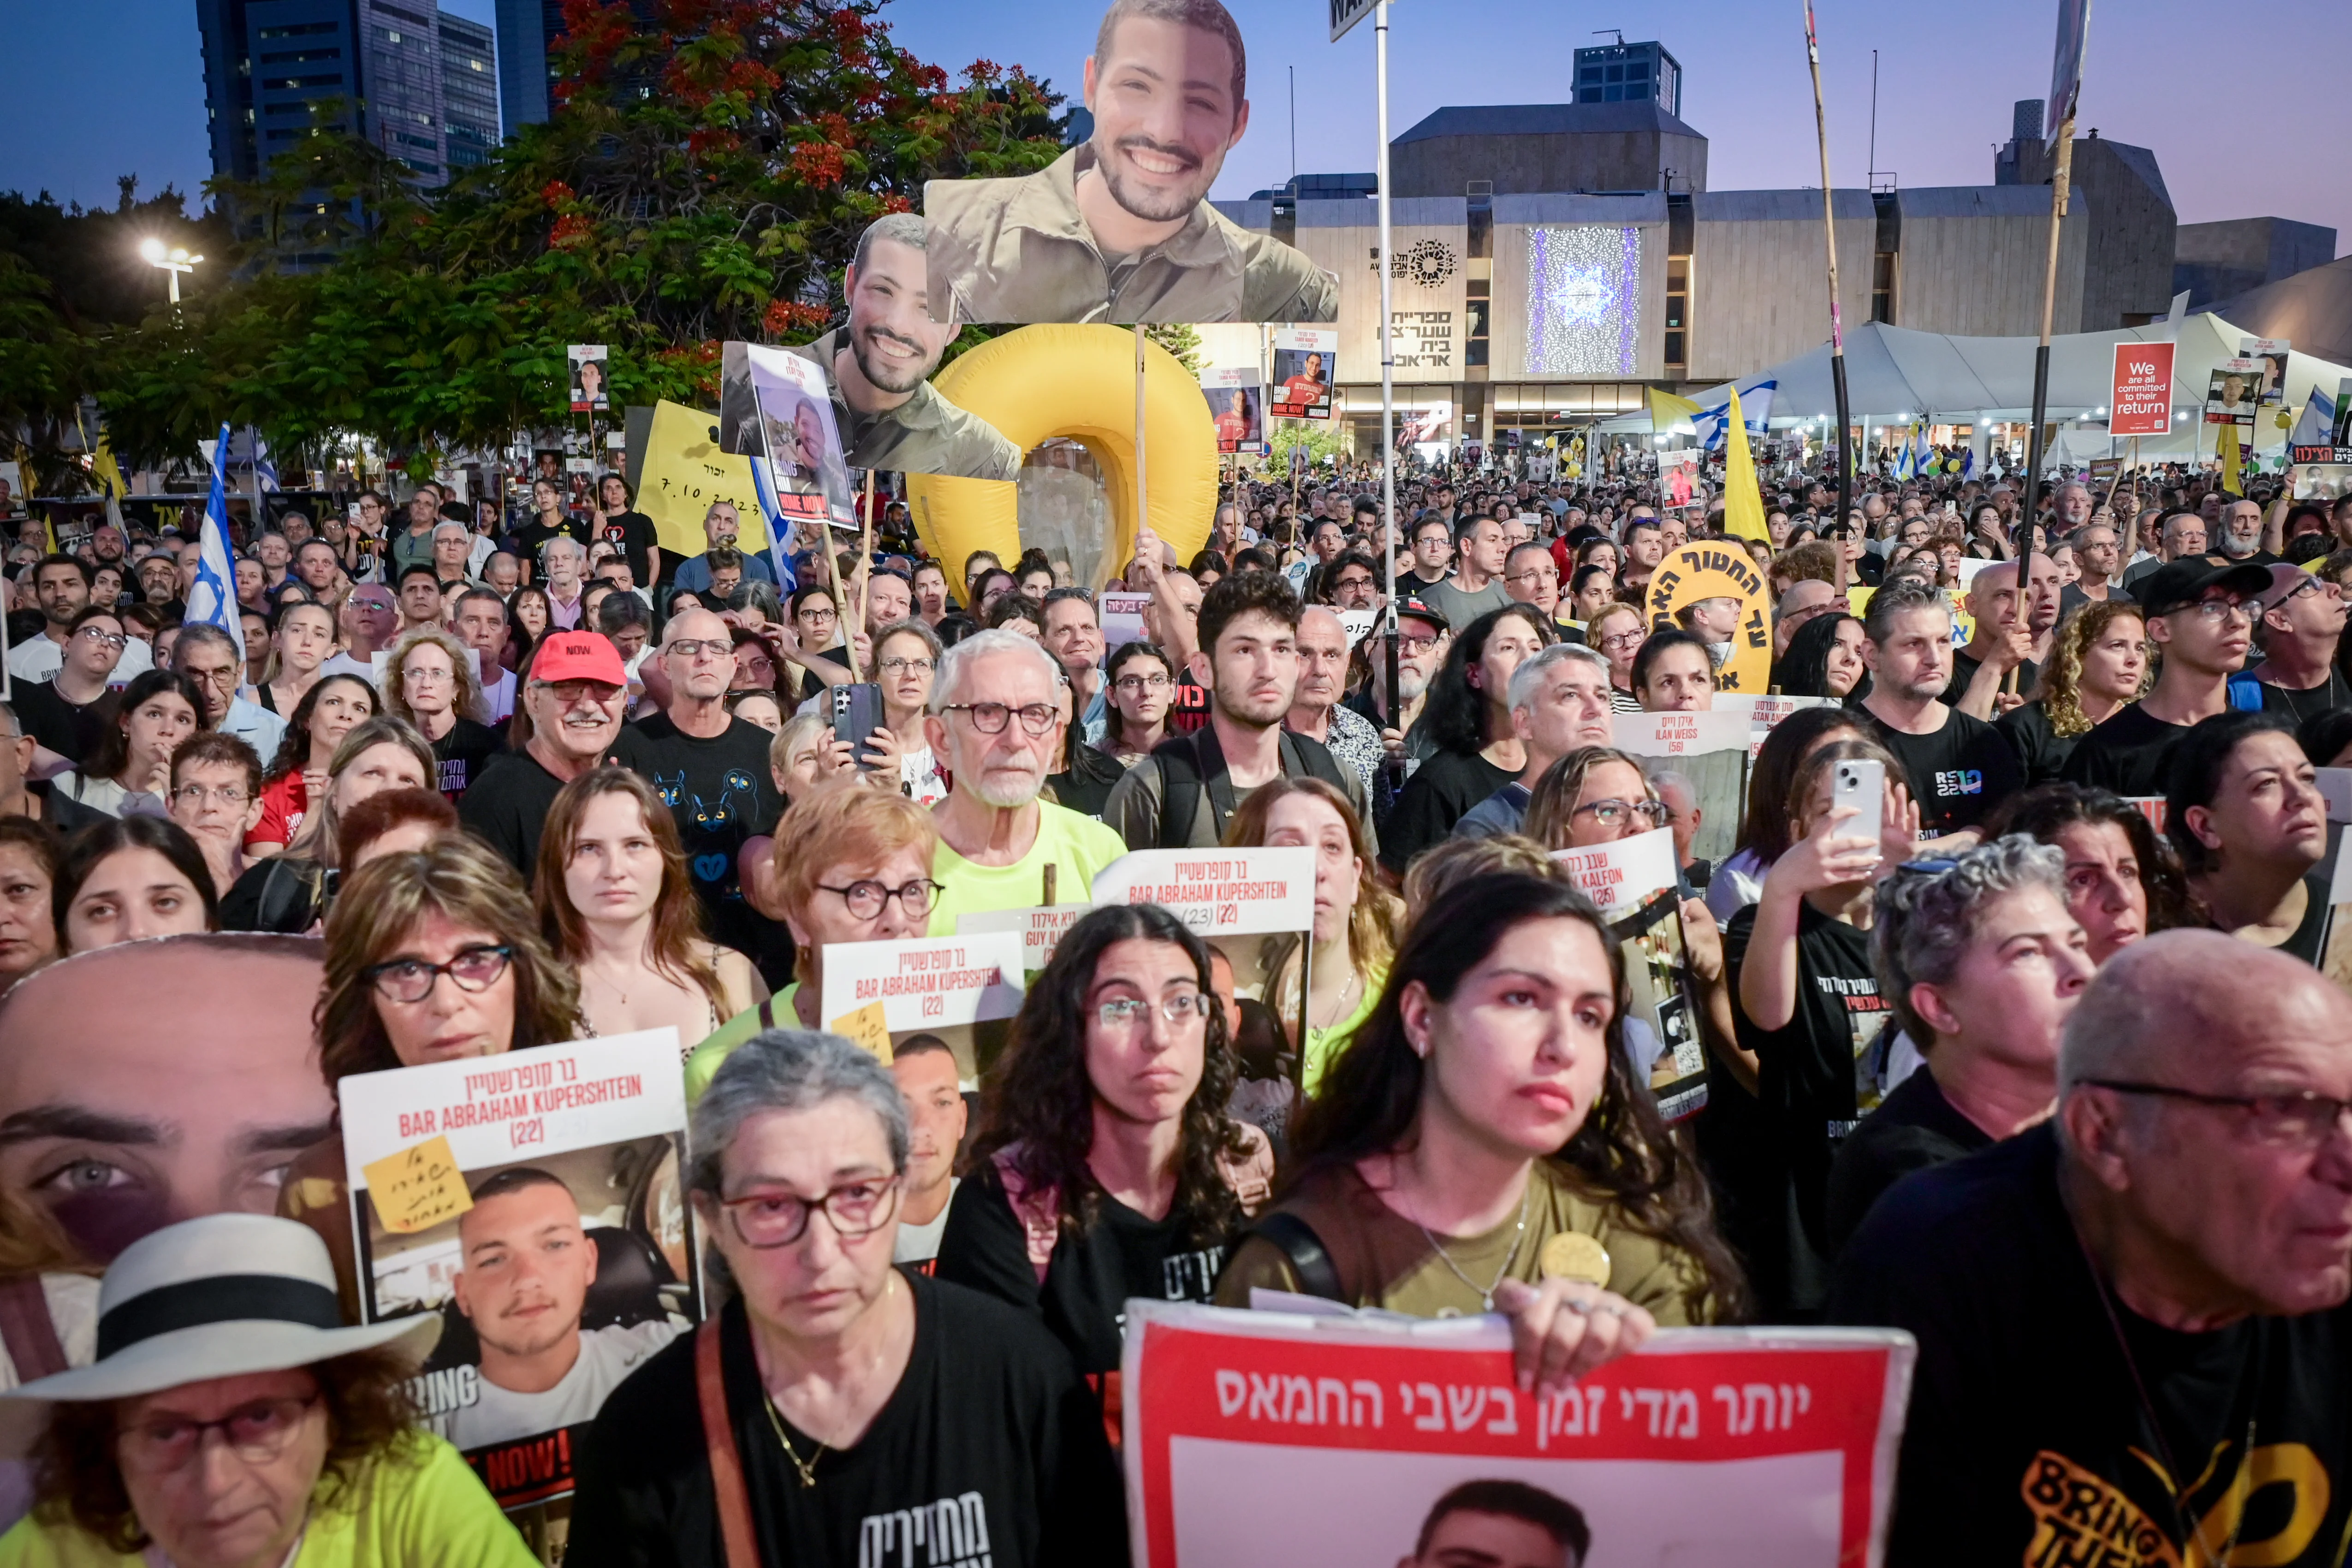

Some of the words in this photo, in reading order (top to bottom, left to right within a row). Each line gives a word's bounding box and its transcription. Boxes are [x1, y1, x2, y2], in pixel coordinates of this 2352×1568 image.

[1391, 312, 1451, 323] ספריית
[1377, 326, 1404, 339] צן
[1420, 340, 1451, 352] בית
[1391, 354, 1450, 367] אריאל
[2129, 362, 2155, 375] We
[1274, 386, 1290, 395] BRING
[2118, 383, 2166, 392] committed
[2136, 392, 2157, 400] their
[1273, 394, 1284, 403] HIM
[1272, 404, 1288, 412] HOME
[2117, 401, 2165, 415] return
[2295, 446, 2333, 461] הצילו!
[704, 464, 725, 478] זכור
[773, 460, 798, 477] BRING
[775, 475, 792, 493] HIM
[779, 493, 802, 511] HOME
[1681, 551, 1761, 596] החטוף
[1108, 600, 1136, 612] בעזה
[1745, 609, 1767, 648] עד
[41, 668, 61, 680] BRIN
[1782, 702, 1794, 712] מתן
[1662, 717, 1676, 727] וייס
[1678, 716, 1693, 728] אילן
[1752, 712, 1769, 721] ATAN
[1656, 729, 1672, 740] ILAN
[1675, 728, 1698, 739] WEISS
[1669, 741, 1683, 753] (56)
[437, 759, 465, 775] מחזירי
[441, 774, 466, 790] אותם
[1175, 861, 1232, 883] קופרשטיין
[1235, 861, 1247, 879] בר
[1581, 867, 1623, 889] KALFON
[1130, 885, 1153, 904] BAR
[1157, 884, 1213, 903] ABRAHAM
[1217, 881, 1287, 900] KUPERSHTEIN
[1182, 908, 1213, 927] (23)
[1026, 931, 1047, 946] GUY
[899, 949, 952, 974] קופרשטיין
[956, 948, 965, 967] בר
[856, 979, 878, 999] BAR
[881, 974, 936, 996] ABRAHAM
[939, 964, 1001, 991] KUPERSHTEIN
[923, 995, 944, 1017] (22)
[562, 1057, 578, 1081] בר
[464, 1061, 553, 1101] קופרשטיין
[398, 1110, 437, 1138] BAR
[442, 1095, 529, 1130] ABRAHAM
[533, 1074, 643, 1114] KUPERSHTEIN
[510, 1116, 545, 1150] (22)
[388, 1364, 479, 1417] RING
[1214, 1369, 1384, 1428] החמאס
[1399, 1383, 1518, 1435] בשבי
[1536, 1384, 1606, 1450] זמן
[1619, 1387, 1699, 1439] מדי
[1712, 1384, 1812, 1435] יותר
[486, 1428, 571, 1492] NOW!
[2031, 1457, 2161, 1556] BRING
